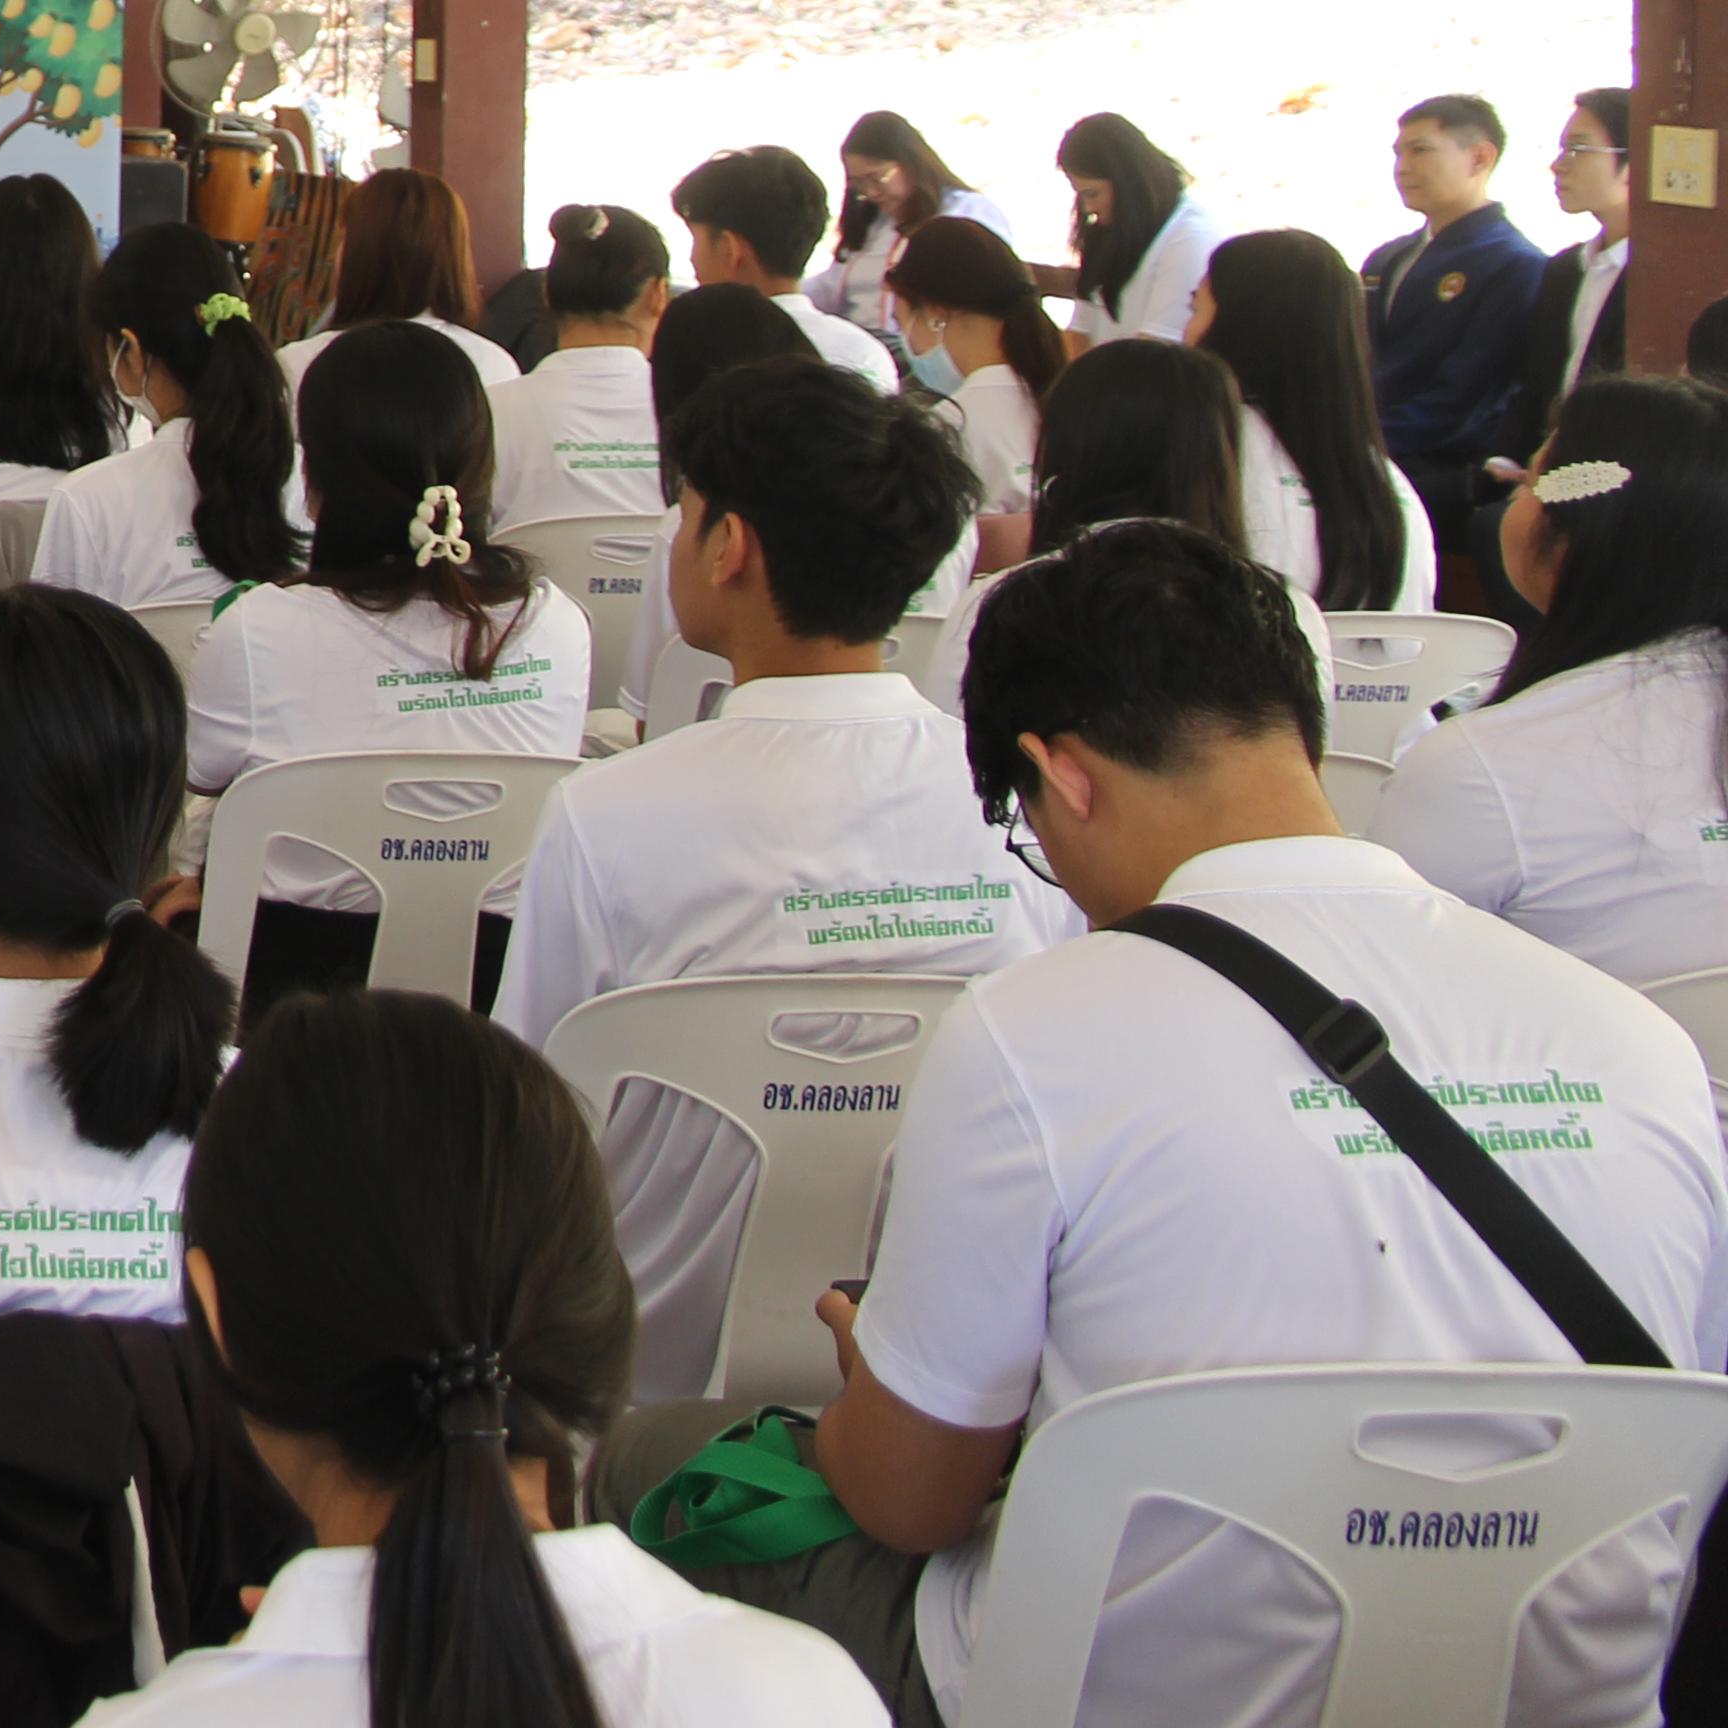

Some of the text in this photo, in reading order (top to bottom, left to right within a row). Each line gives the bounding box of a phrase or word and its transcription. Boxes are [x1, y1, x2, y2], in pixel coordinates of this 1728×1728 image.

[397, 680, 544, 713] พร้อมใจไปเลือกตั้ง
[380, 837, 490, 862] อช.คลองลาน
[782, 874, 1013, 913] สร้างสรรค์ประเทศไทย
[807, 906, 995, 946] พร้อมใจไปเลือกตั้ง
[762, 1082, 901, 1113] อช.คลองลาน
[1344, 1506, 1541, 1550] อช.คลองลาน
